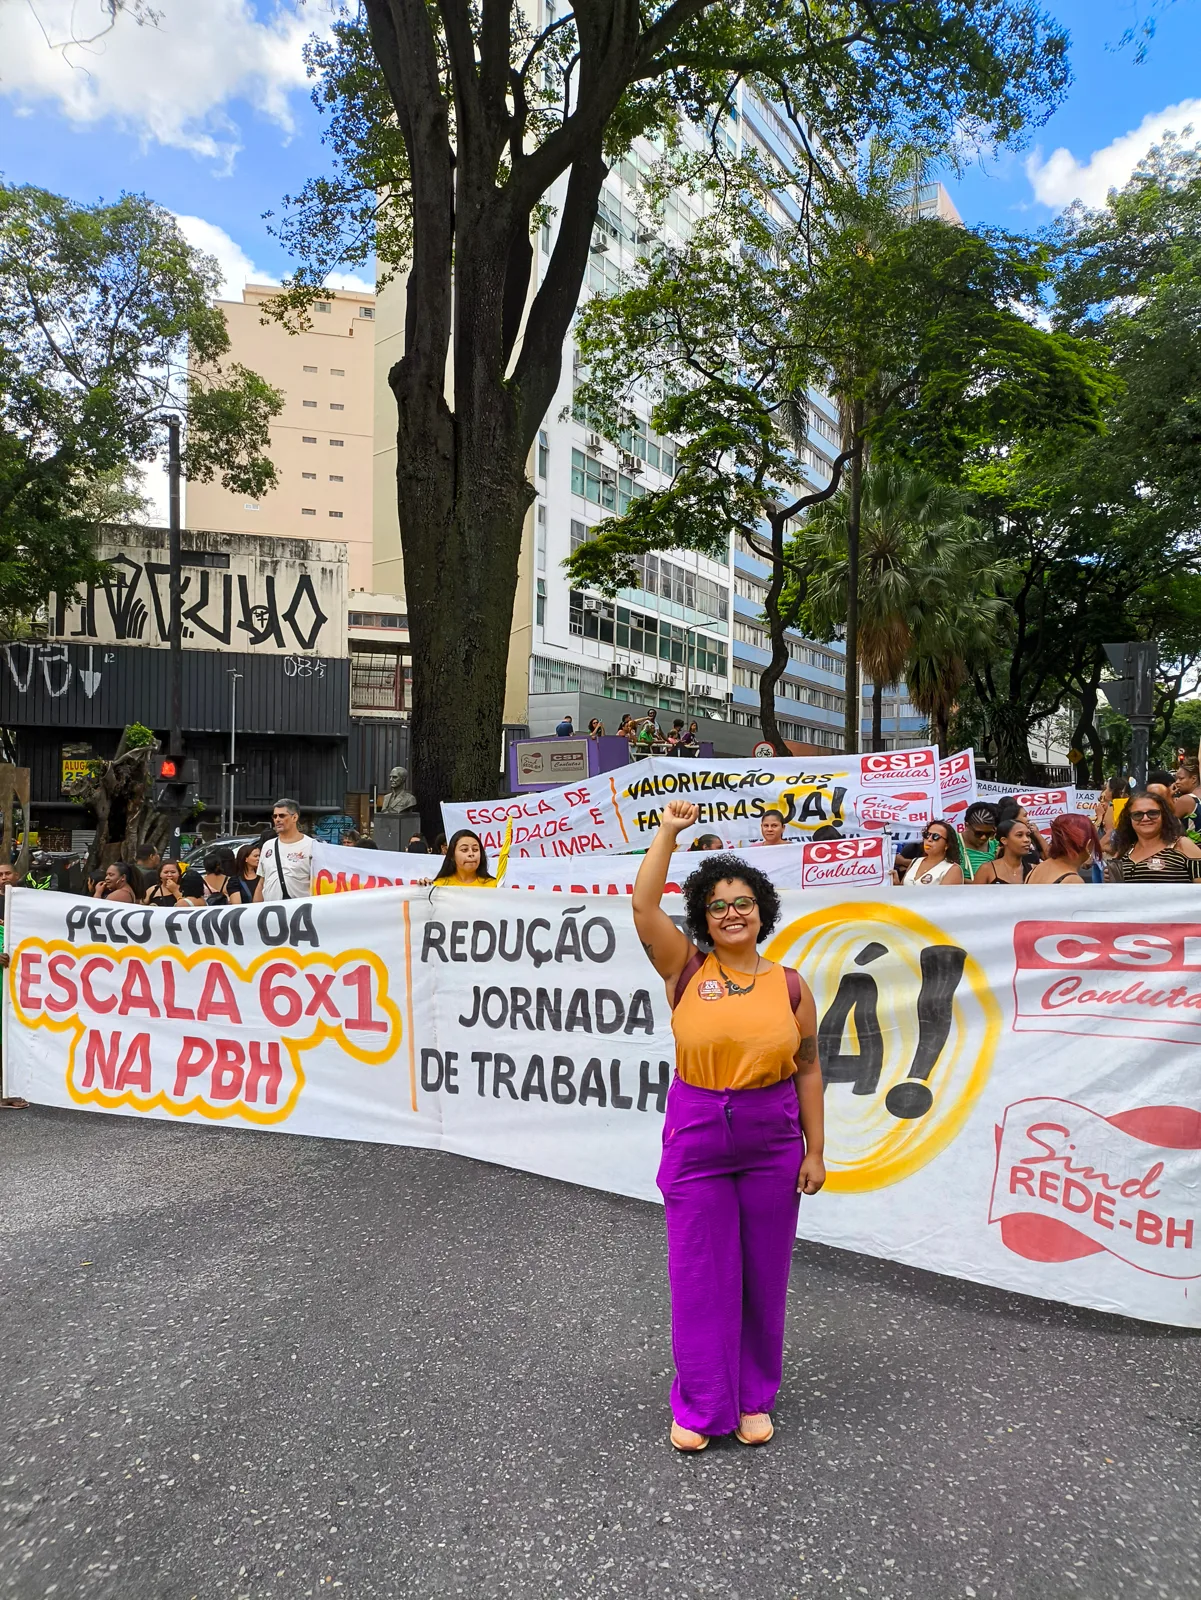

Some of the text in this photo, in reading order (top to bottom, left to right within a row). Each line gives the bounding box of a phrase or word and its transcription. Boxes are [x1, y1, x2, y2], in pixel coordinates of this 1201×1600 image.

[867, 753, 927, 771] CSP
[939, 757, 965, 779] SP
[627, 768, 834, 800] VALORIZAÇÃO das
[1017, 792, 1062, 807] CSP
[1075, 792, 1095, 801] IXAS
[466, 787, 591, 825] ESCOLA DE
[637, 784, 848, 832] FAEIRAS JÁ!
[861, 810, 928, 822] REDE-BH
[863, 797, 910, 811] Sind
[1027, 805, 1064, 816] nlutas
[478, 816, 573, 850] ALIDADE
[810, 838, 877, 862] CSP
[805, 861, 878, 883] Conlutas
[66, 904, 154, 944] PELO
[165, 907, 247, 946] FIM
[421, 904, 616, 968] REDUÇÃO
[20, 952, 243, 1024] ESCALA
[1041, 976, 1201, 1010] Conluta
[458, 985, 655, 1035] JORNADA
[818, 942, 968, 1120] Á!
[82, 1029, 283, 1105] NA PBH
[421, 1048, 670, 1114] DE TRABALH
[1020, 1122, 1165, 1199] Sind
[1009, 1166, 1195, 1249] REDE-BH
